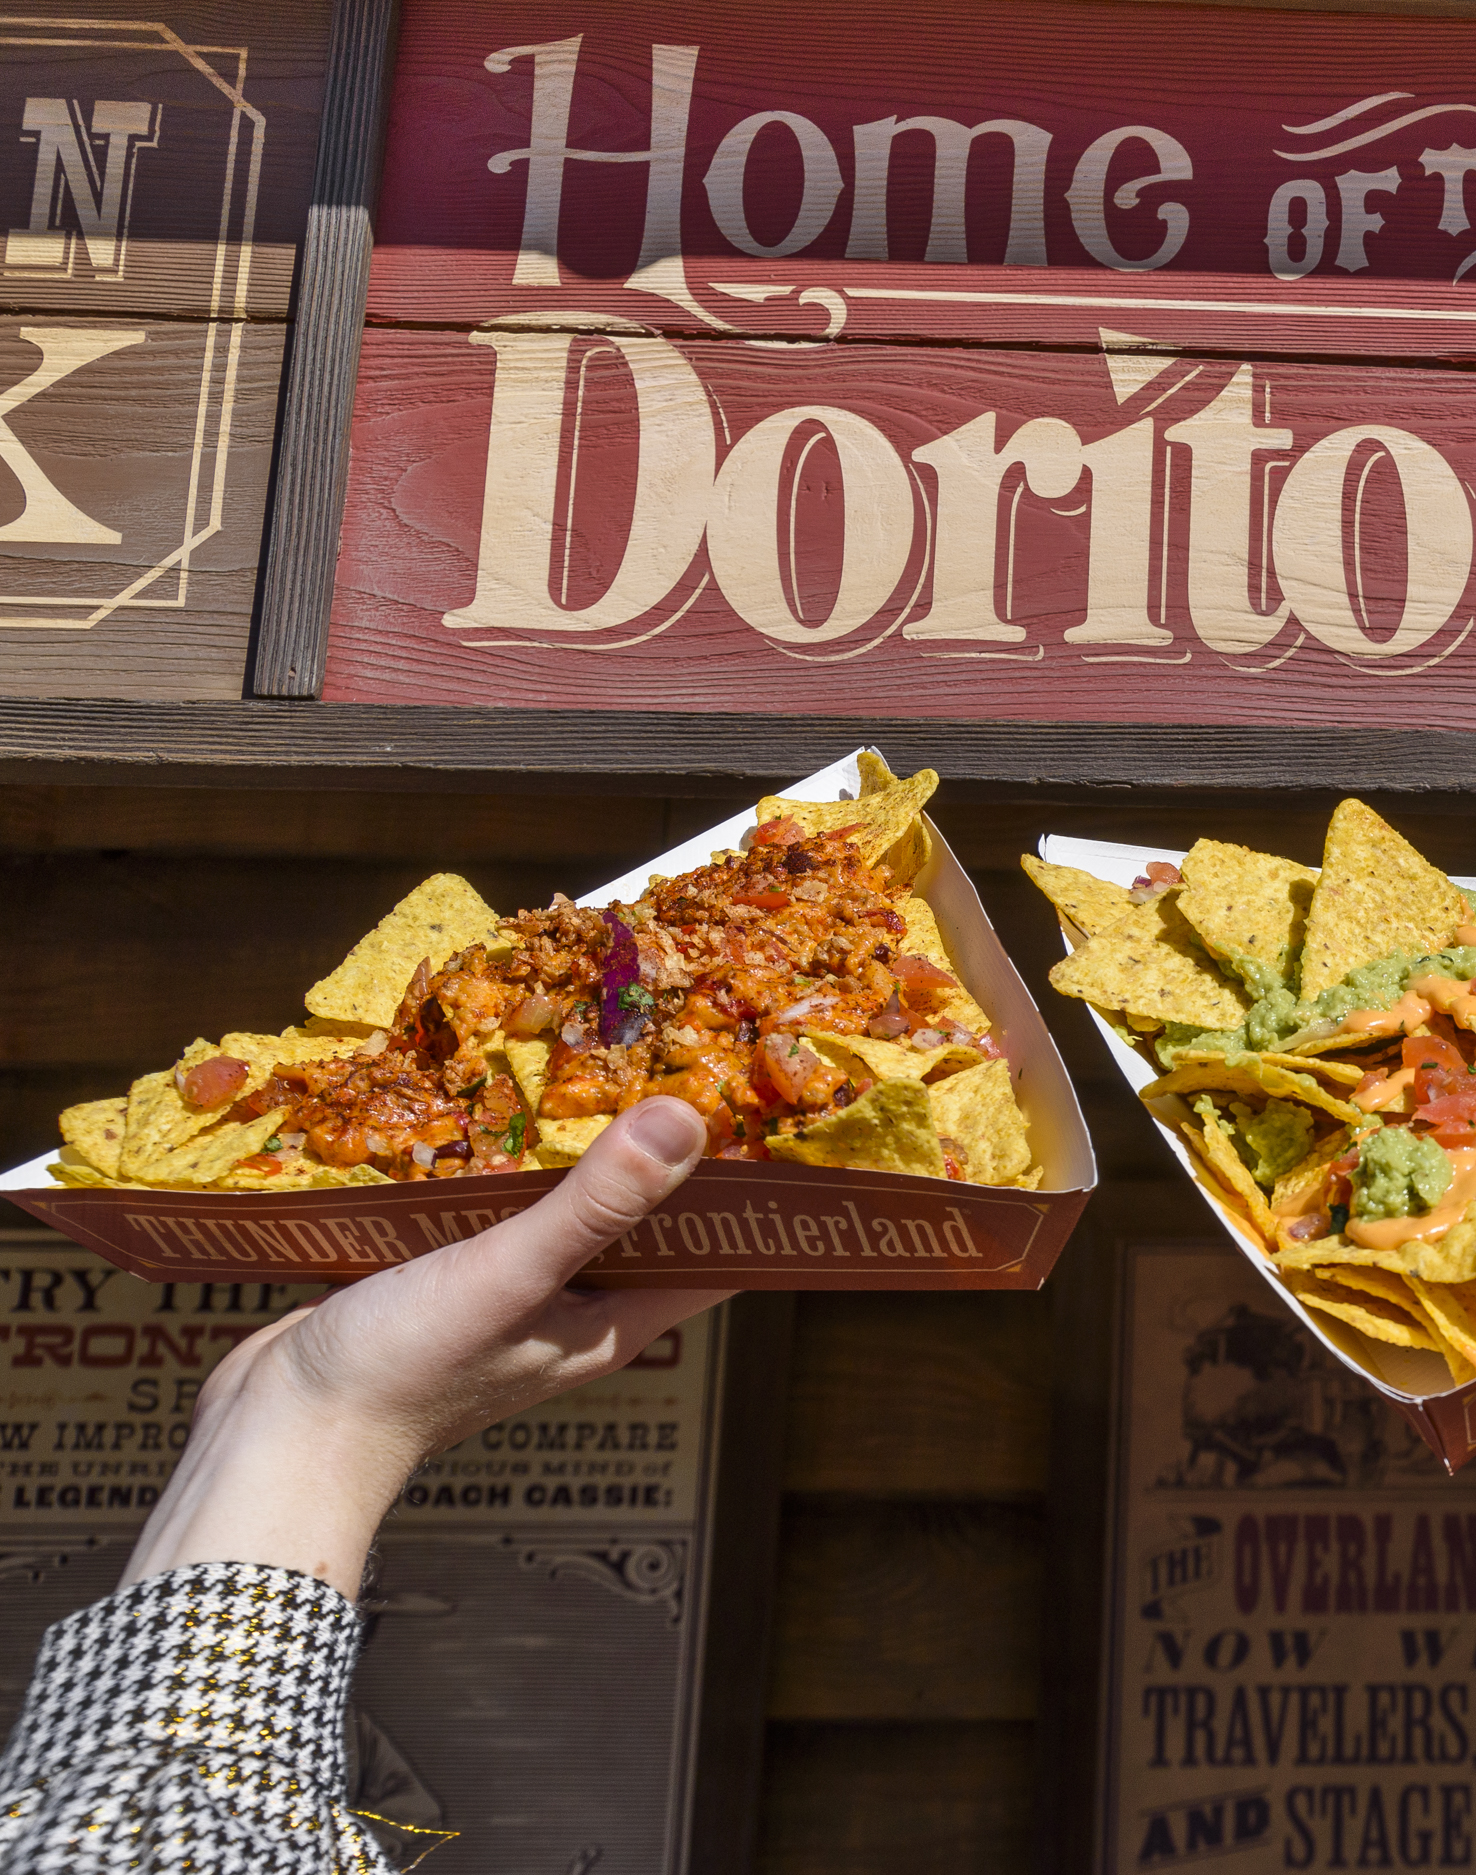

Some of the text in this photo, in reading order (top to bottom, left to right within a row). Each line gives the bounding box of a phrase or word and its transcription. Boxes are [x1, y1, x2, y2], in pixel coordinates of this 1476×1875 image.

[484, 33, 1193, 347] Home
[1264, 165, 1402, 281] OF
[125, 1214, 413, 1263] THUNDER
[618, 1200, 984, 1259] Frontierland
[0, 1266, 119, 1314] RY
[53, 1421, 192, 1451] IMPRO
[480, 1421, 679, 1452] COMPARE
[404, 1483, 675, 1509] OACH CASSIE:
[1148, 1545, 1215, 1595] THE
[1143, 1625, 1329, 1676] NOW
[1136, 1793, 1271, 1868] AND
[1283, 1782, 1473, 1869] STAGE
